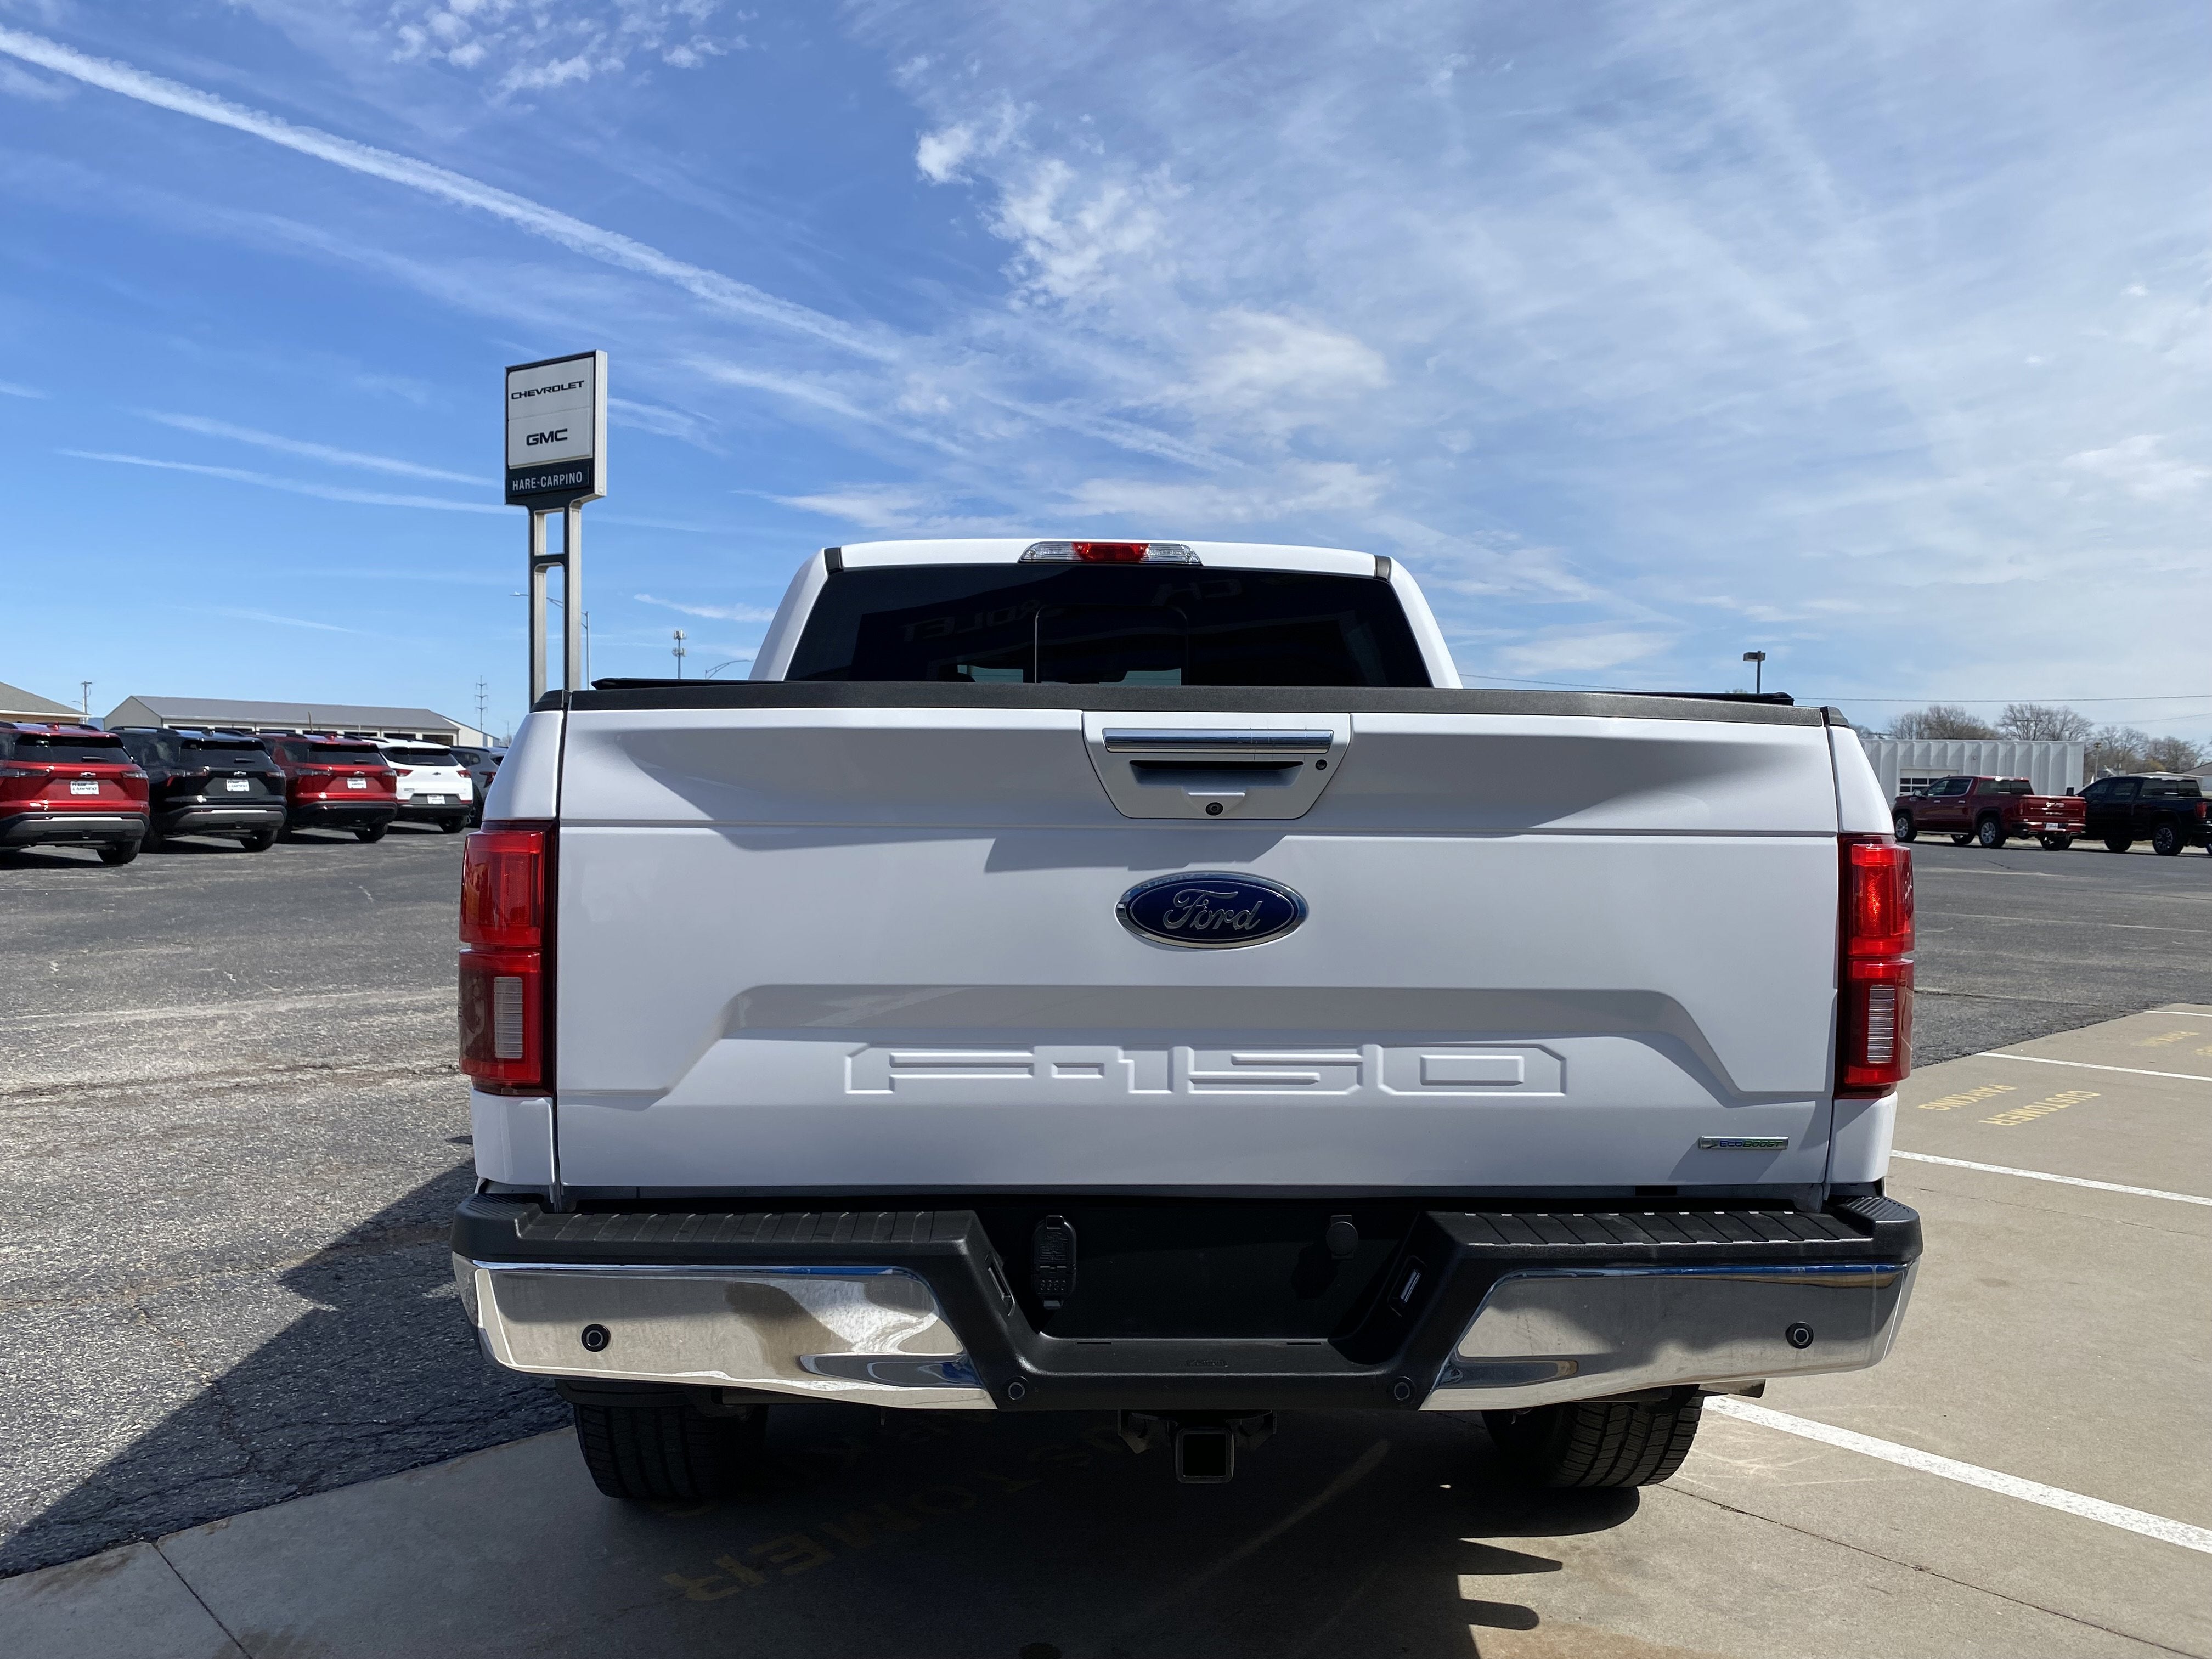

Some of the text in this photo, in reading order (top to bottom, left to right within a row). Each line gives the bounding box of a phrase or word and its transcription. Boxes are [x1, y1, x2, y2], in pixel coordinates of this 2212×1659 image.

[511, 380, 585, 400] CHEVROLET
[526, 428, 568, 446] GMC
[512, 471, 582, 491] HARE-CARPINO
[1163, 889, 1263, 930] Ford
[845, 1043, 1565, 1096] F-150
[1917, 1084, 2018, 1111] PARKING
[1978, 1091, 2101, 1126] CUSTOMER
